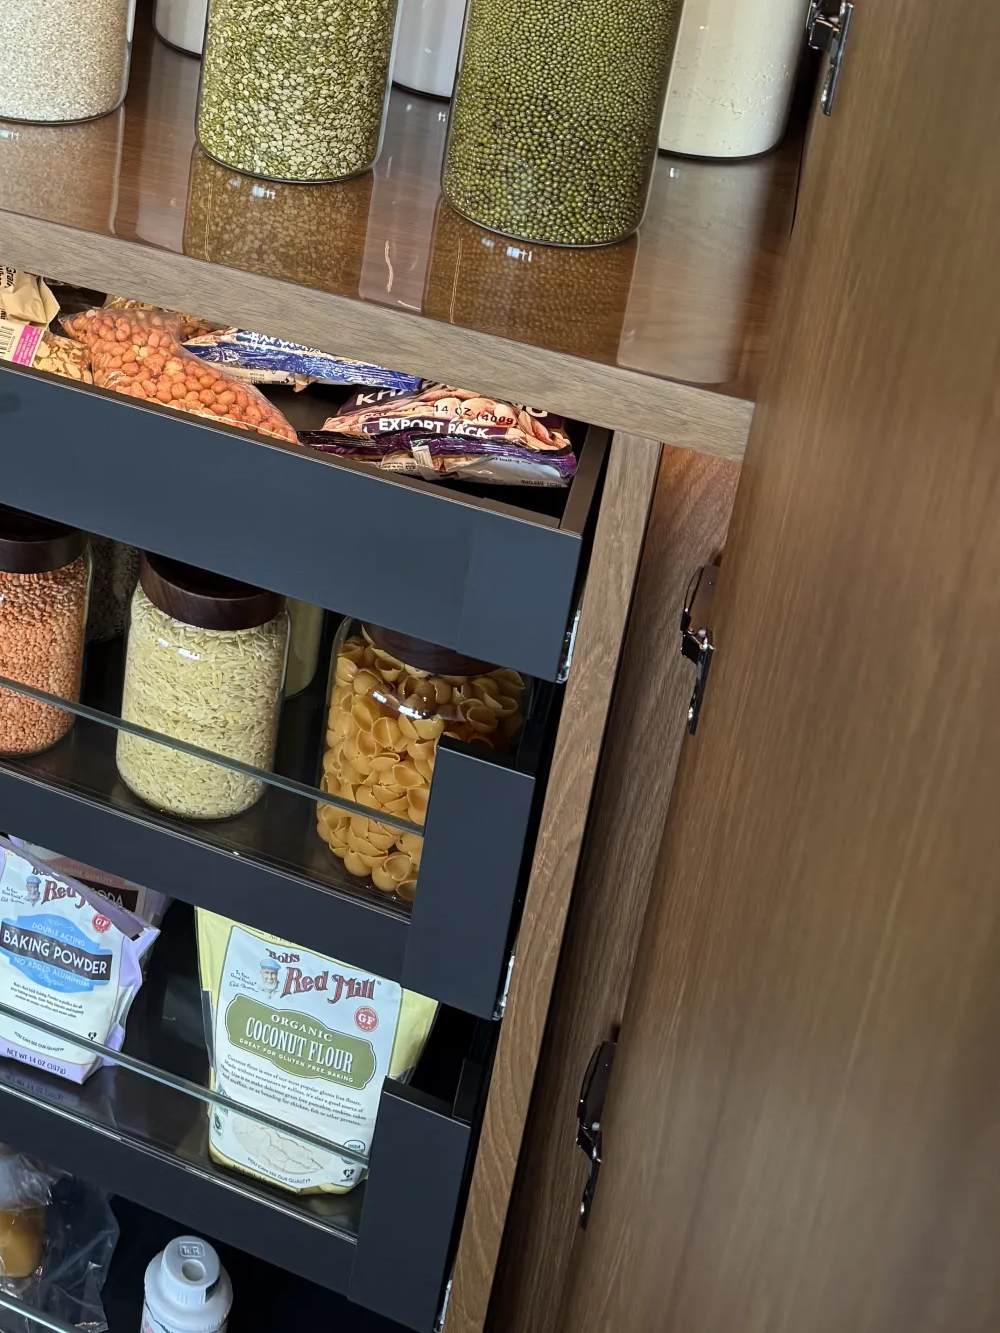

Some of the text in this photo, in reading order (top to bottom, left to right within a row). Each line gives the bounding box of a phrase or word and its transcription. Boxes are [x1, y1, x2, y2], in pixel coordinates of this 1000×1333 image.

[379, 417, 490, 439] EXPORT PACK
[32, 922, 86, 947] DOUBLE ACTING
[95, 917, 109, 927] GF
[3, 930, 107, 974] BAKING POWDER
[265, 948, 301, 964] Bob's
[13, 957, 90, 987] NO ADDED ALUMINUM
[280, 966, 376, 1004] Red Mill
[271, 1014, 332, 1042] ORGANIC
[358, 1013, 376, 1025] GF
[13, 1030, 22, 1039] YOU
[22, 1035, 31, 1043] CAN
[246, 1017, 353, 1074] COCONUT FLOUR
[6, 1048, 18, 1057] NET
[37, 1059, 46, 1067] OZ
[47, 1062, 67, 1075] (397g)
[224, 1059, 236, 1068] Made
[239, 1038, 354, 1083] GREAT FOR GLUTEN FREE BAKING
[228, 1054, 245, 1065] Coconut
[246, 1062, 257, 1070] flour
[300, 1082, 318, 1093] popular
[335, 1093, 344, 1101] free
[247, 1156, 257, 1167] YOU
[257, 1163, 268, 1172] CAN
[277, 1173, 287, 1181] OUR
